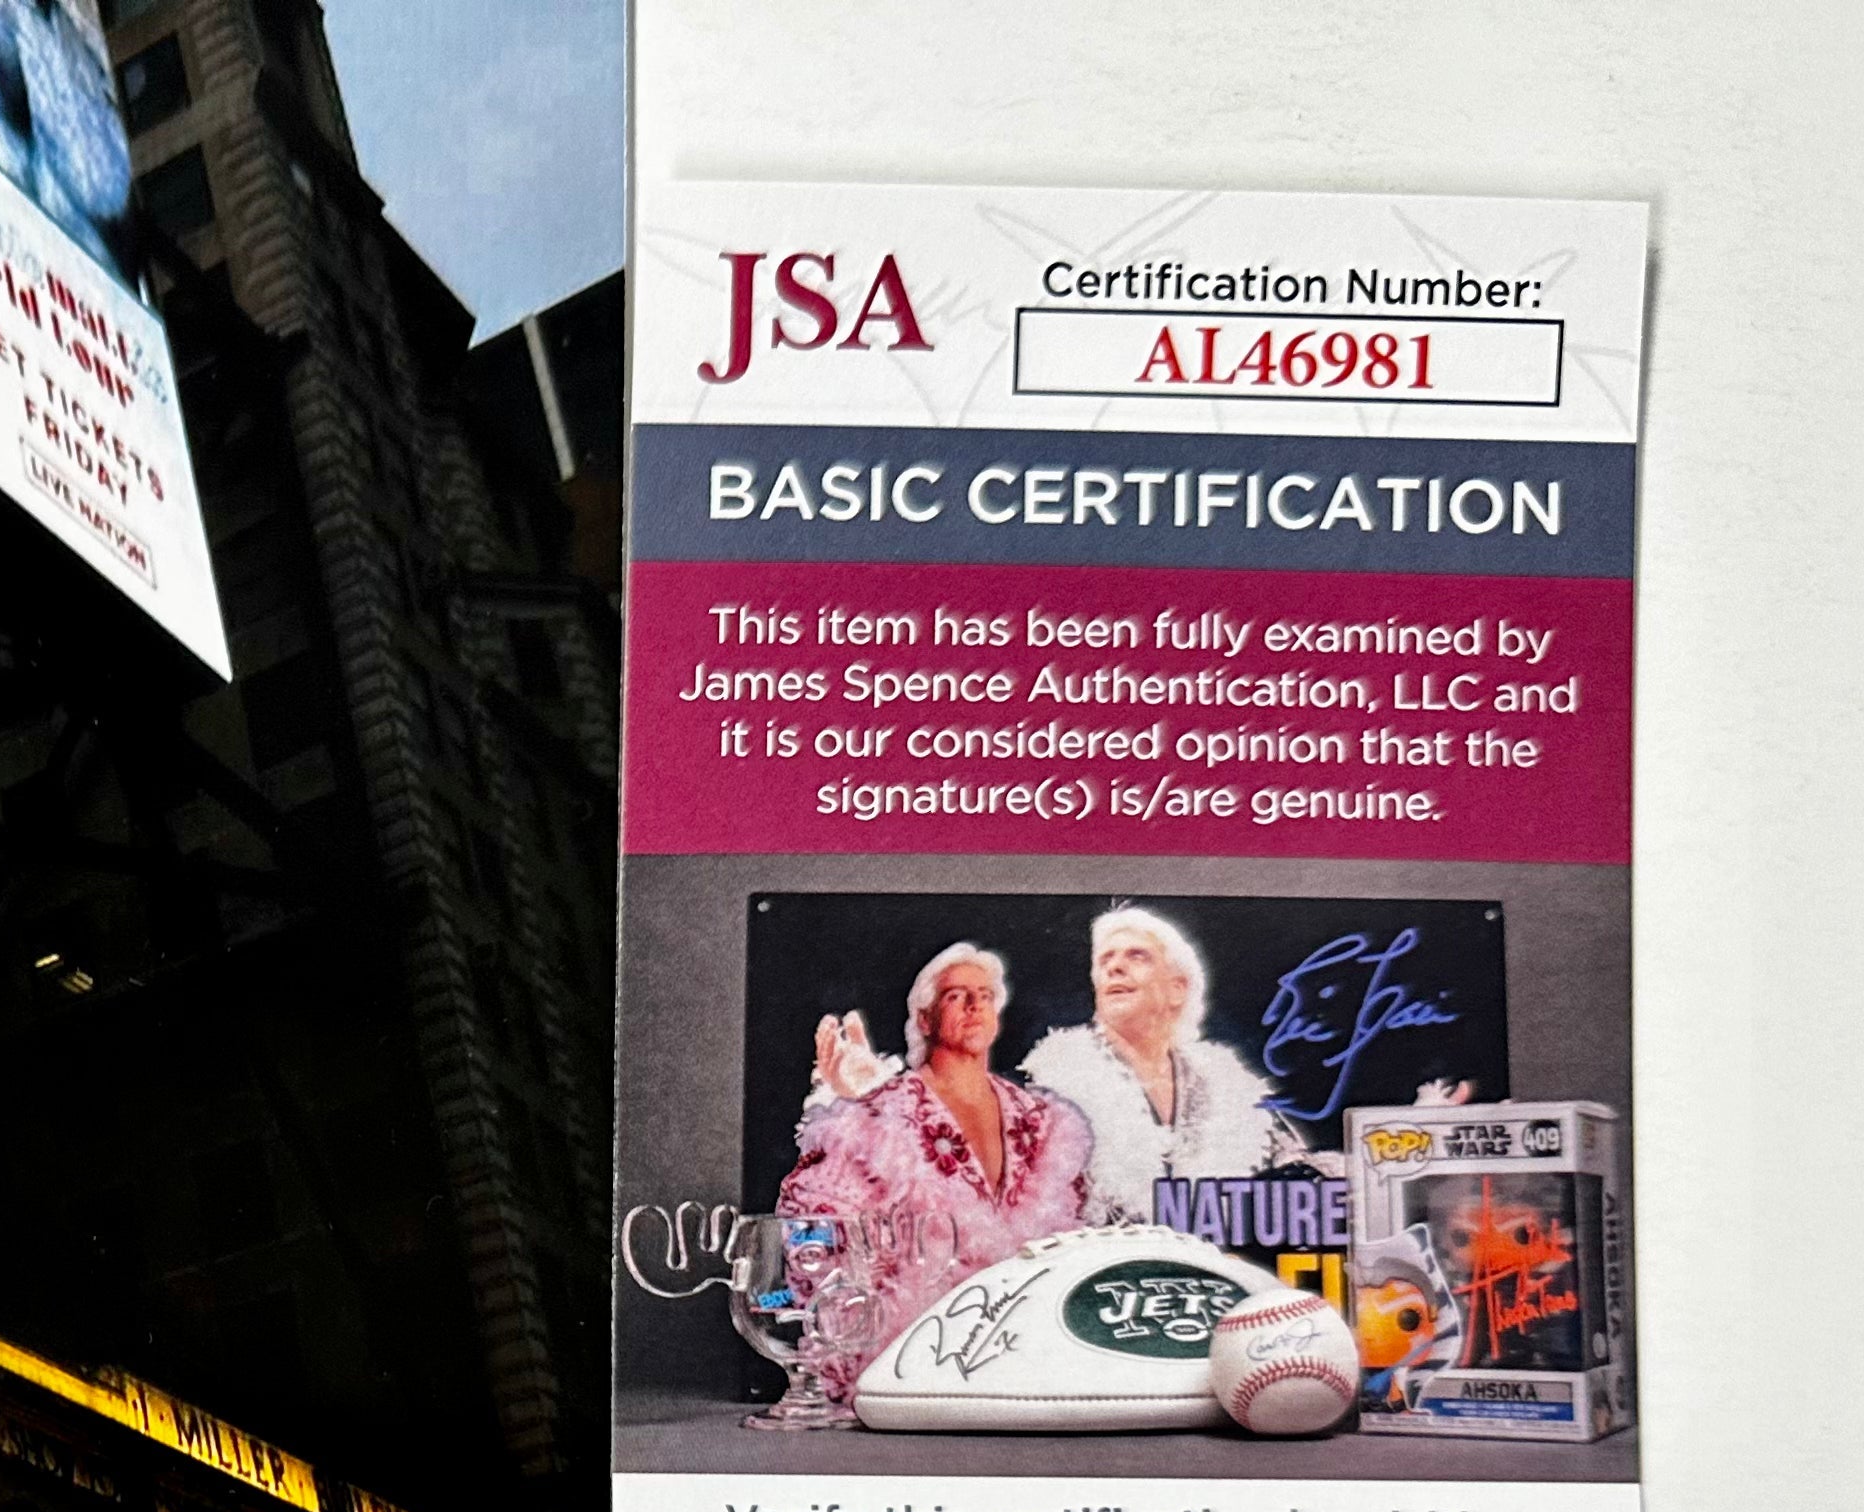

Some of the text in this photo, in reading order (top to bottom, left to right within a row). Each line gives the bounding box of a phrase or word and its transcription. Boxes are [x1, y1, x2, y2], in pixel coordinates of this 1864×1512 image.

[1043, 261, 1541, 308] Certification Number:
[697, 252, 935, 384] JSA
[1135, 325, 1433, 389] AL46981
[24, 395, 128, 507] FRIDAY
[41, 369, 165, 503] TICKETS
[709, 463, 1560, 535] BASIC CERTIFICATION
[708, 605, 1552, 665] This item has been fully examined by
[678, 662, 1578, 714] James Spence Authentication, LLC and
[720, 719, 1539, 768] it is our considered opinion that the
[816, 775, 1443, 825] signature(s) is/are genuine.
[1443, 1125, 1512, 1140] STAR
[1444, 1139, 1513, 1157] WARS
[1522, 1126, 1562, 1151] 409
[1154, 1178, 1350, 1248] NATURE
[1099, 1291, 1236, 1325] JETS
[1459, 1380, 1538, 1402] AHSOKA
[169, 1396, 294, 1500] MILLER
